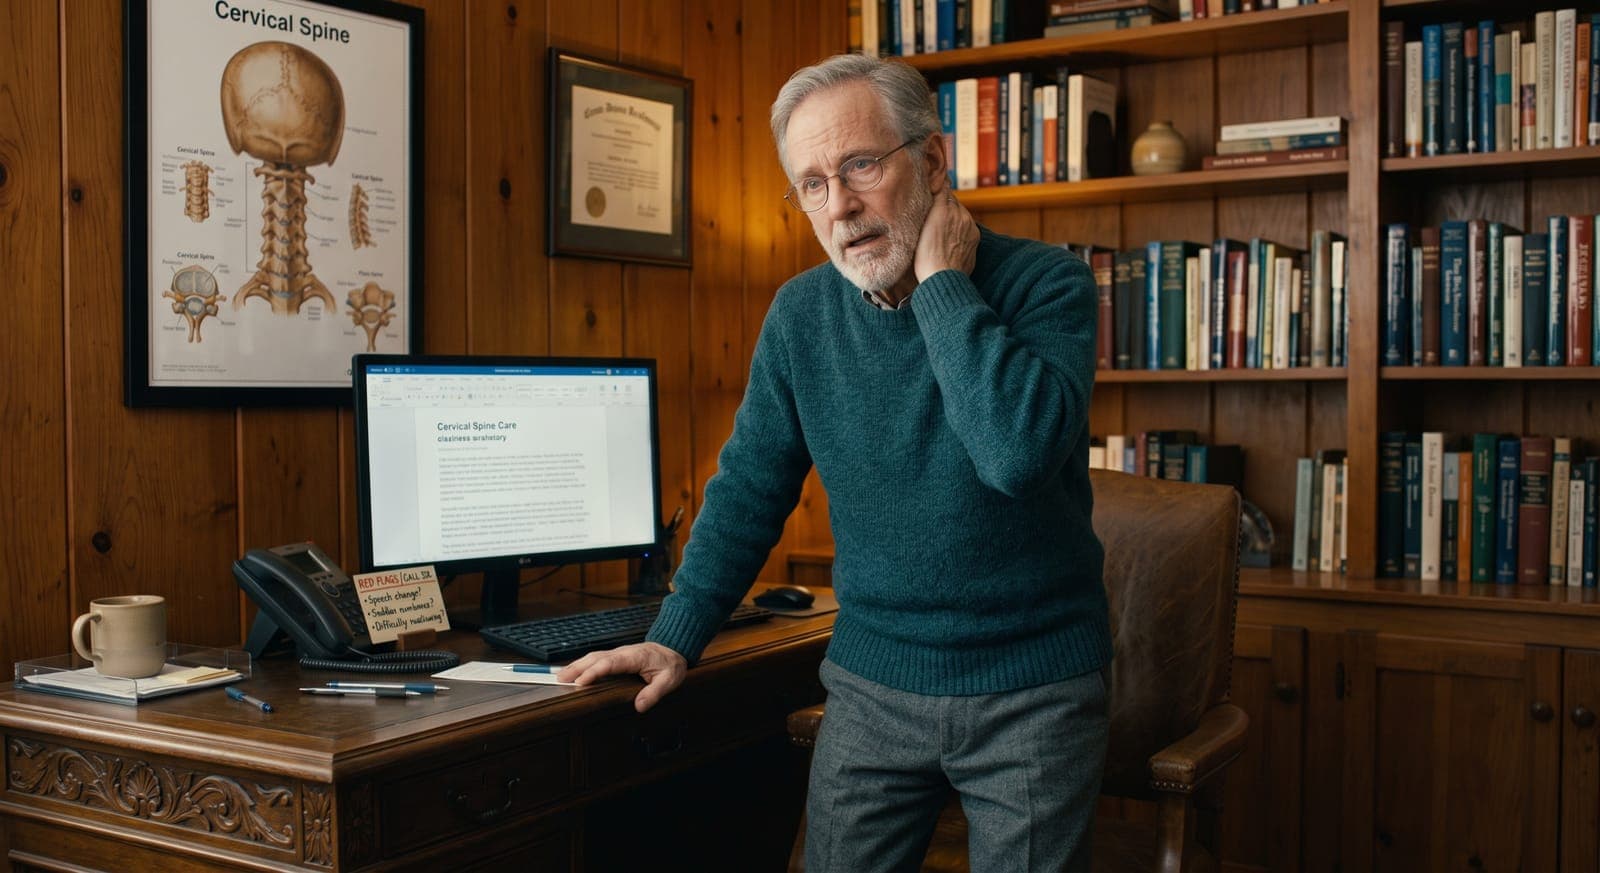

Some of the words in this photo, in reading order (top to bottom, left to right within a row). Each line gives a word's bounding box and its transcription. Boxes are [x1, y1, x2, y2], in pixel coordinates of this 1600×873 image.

[215, 0, 294, 33] Cervical
[299, 17, 350, 44] Spine
[437, 422, 470, 431] Cervical
[472, 421, 496, 431] Spine
[498, 421, 517, 430] Care
[358, 577, 374, 589] RED
[376, 575, 399, 587] FLAGS
[403, 572, 418, 582] CALL
[368, 593, 392, 606] Speech
